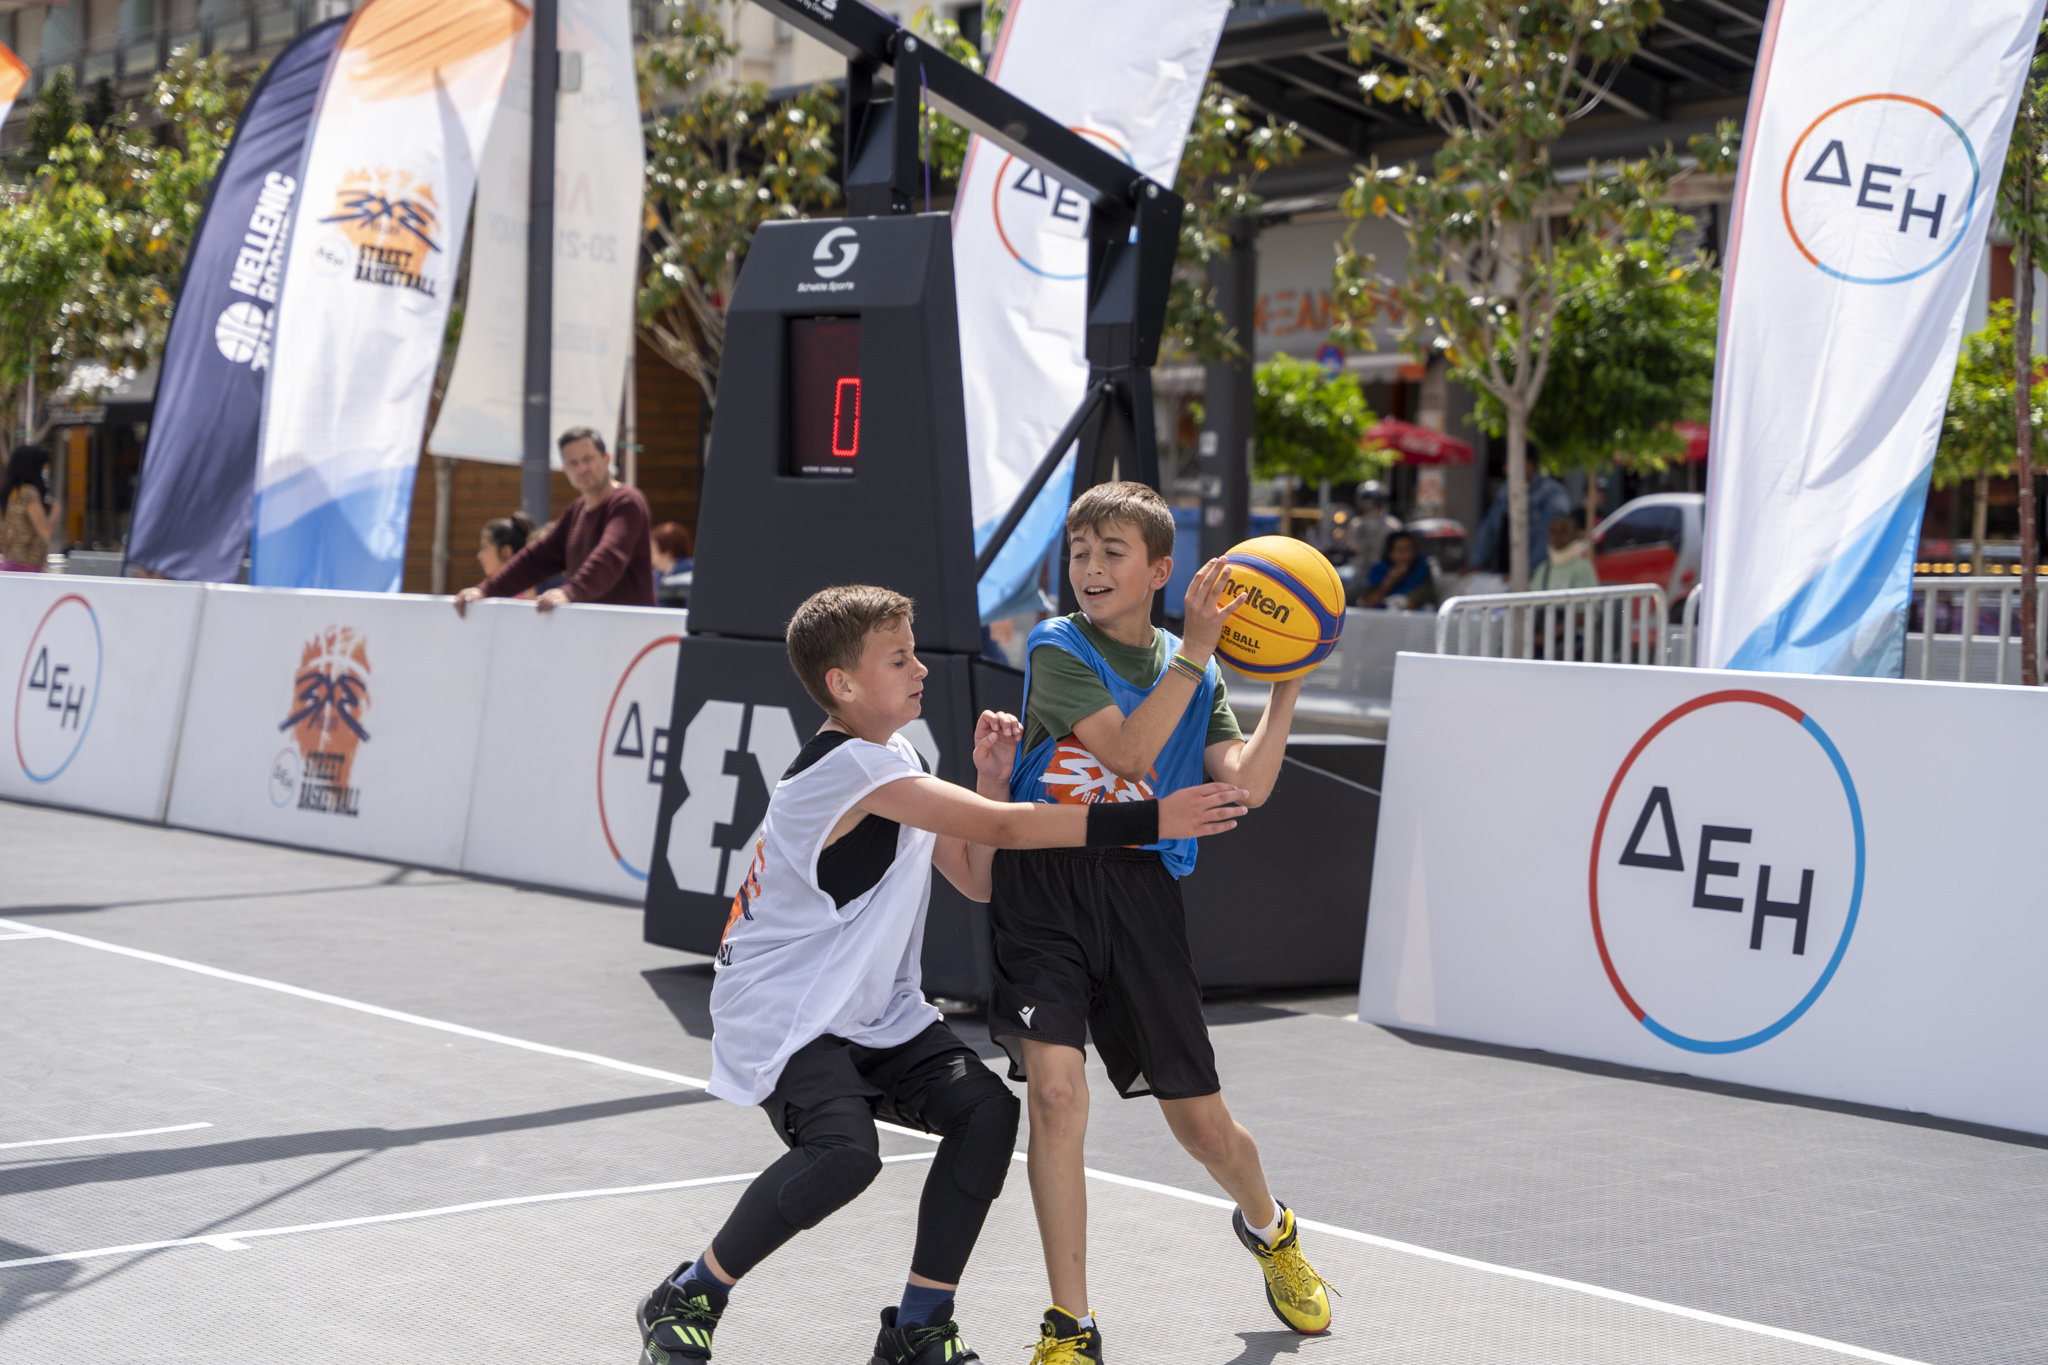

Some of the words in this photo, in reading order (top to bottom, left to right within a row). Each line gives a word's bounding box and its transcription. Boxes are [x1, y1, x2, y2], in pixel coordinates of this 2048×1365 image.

[1012, 165, 1083, 226] ΔE
[229, 171, 297, 297] HELLENIC
[358, 244, 412, 268] STREET
[355, 264, 436, 298] BASKETBALL
[828, 281, 855, 293] Sports
[832, 377, 861, 457] 0
[1225, 637, 1256, 654] APPROVED
[1233, 630, 1261, 649] BALL
[613, 700, 670, 784] ΔE
[303, 750, 346, 783] STREET
[298, 782, 361, 818] BASKETBALL
